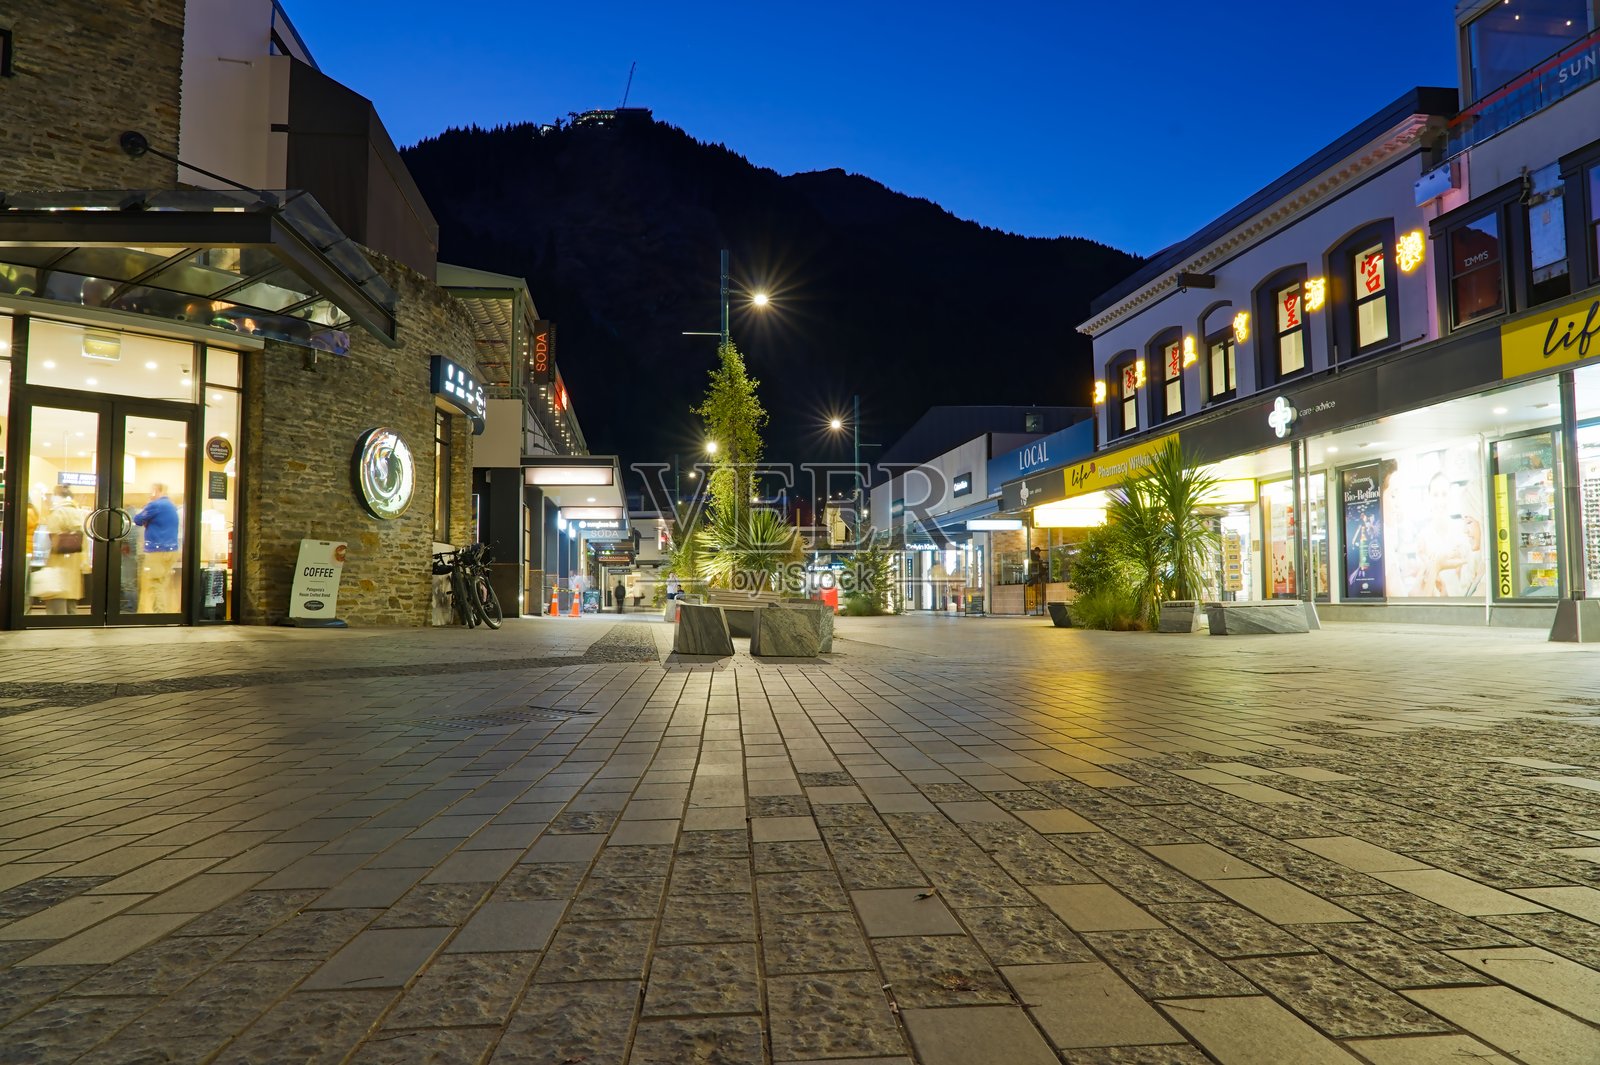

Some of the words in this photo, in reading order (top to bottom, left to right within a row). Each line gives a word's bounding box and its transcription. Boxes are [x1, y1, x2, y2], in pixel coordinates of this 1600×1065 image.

[1543, 300, 1600, 358] lif
[536, 332, 547, 372] SODA
[1019, 441, 1050, 471] LOCAL
[1071, 464, 1092, 489] life
[1098, 462, 1128, 480] Pharmacy
[303, 567, 334, 578] COFFEE
